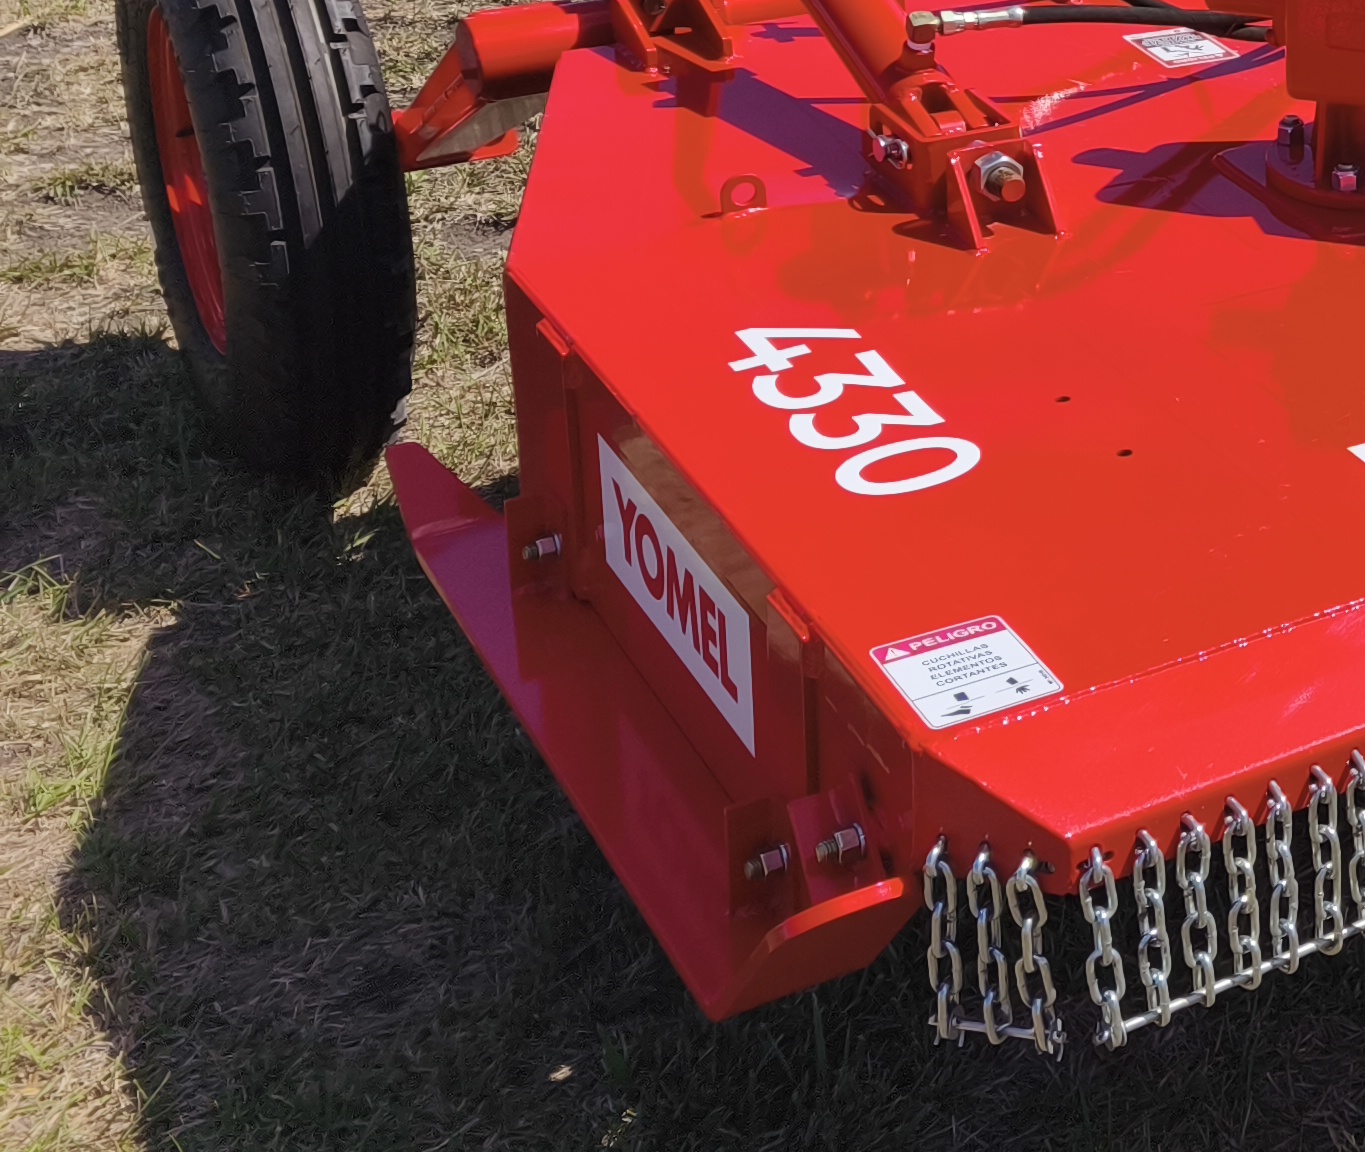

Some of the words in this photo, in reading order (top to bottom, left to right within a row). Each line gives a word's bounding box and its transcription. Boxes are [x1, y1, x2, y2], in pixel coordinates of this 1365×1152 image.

[727, 327, 982, 496] 4330
[611, 478, 739, 705] YOMEL
[908, 621, 998, 652] PELIGRO
[921, 643, 989, 666] CUCHILLAS
[928, 650, 993, 673] ROTATIVAS
[929, 655, 1003, 681] ELEMENTOS
[936, 662, 1008, 687] CORTANTES
